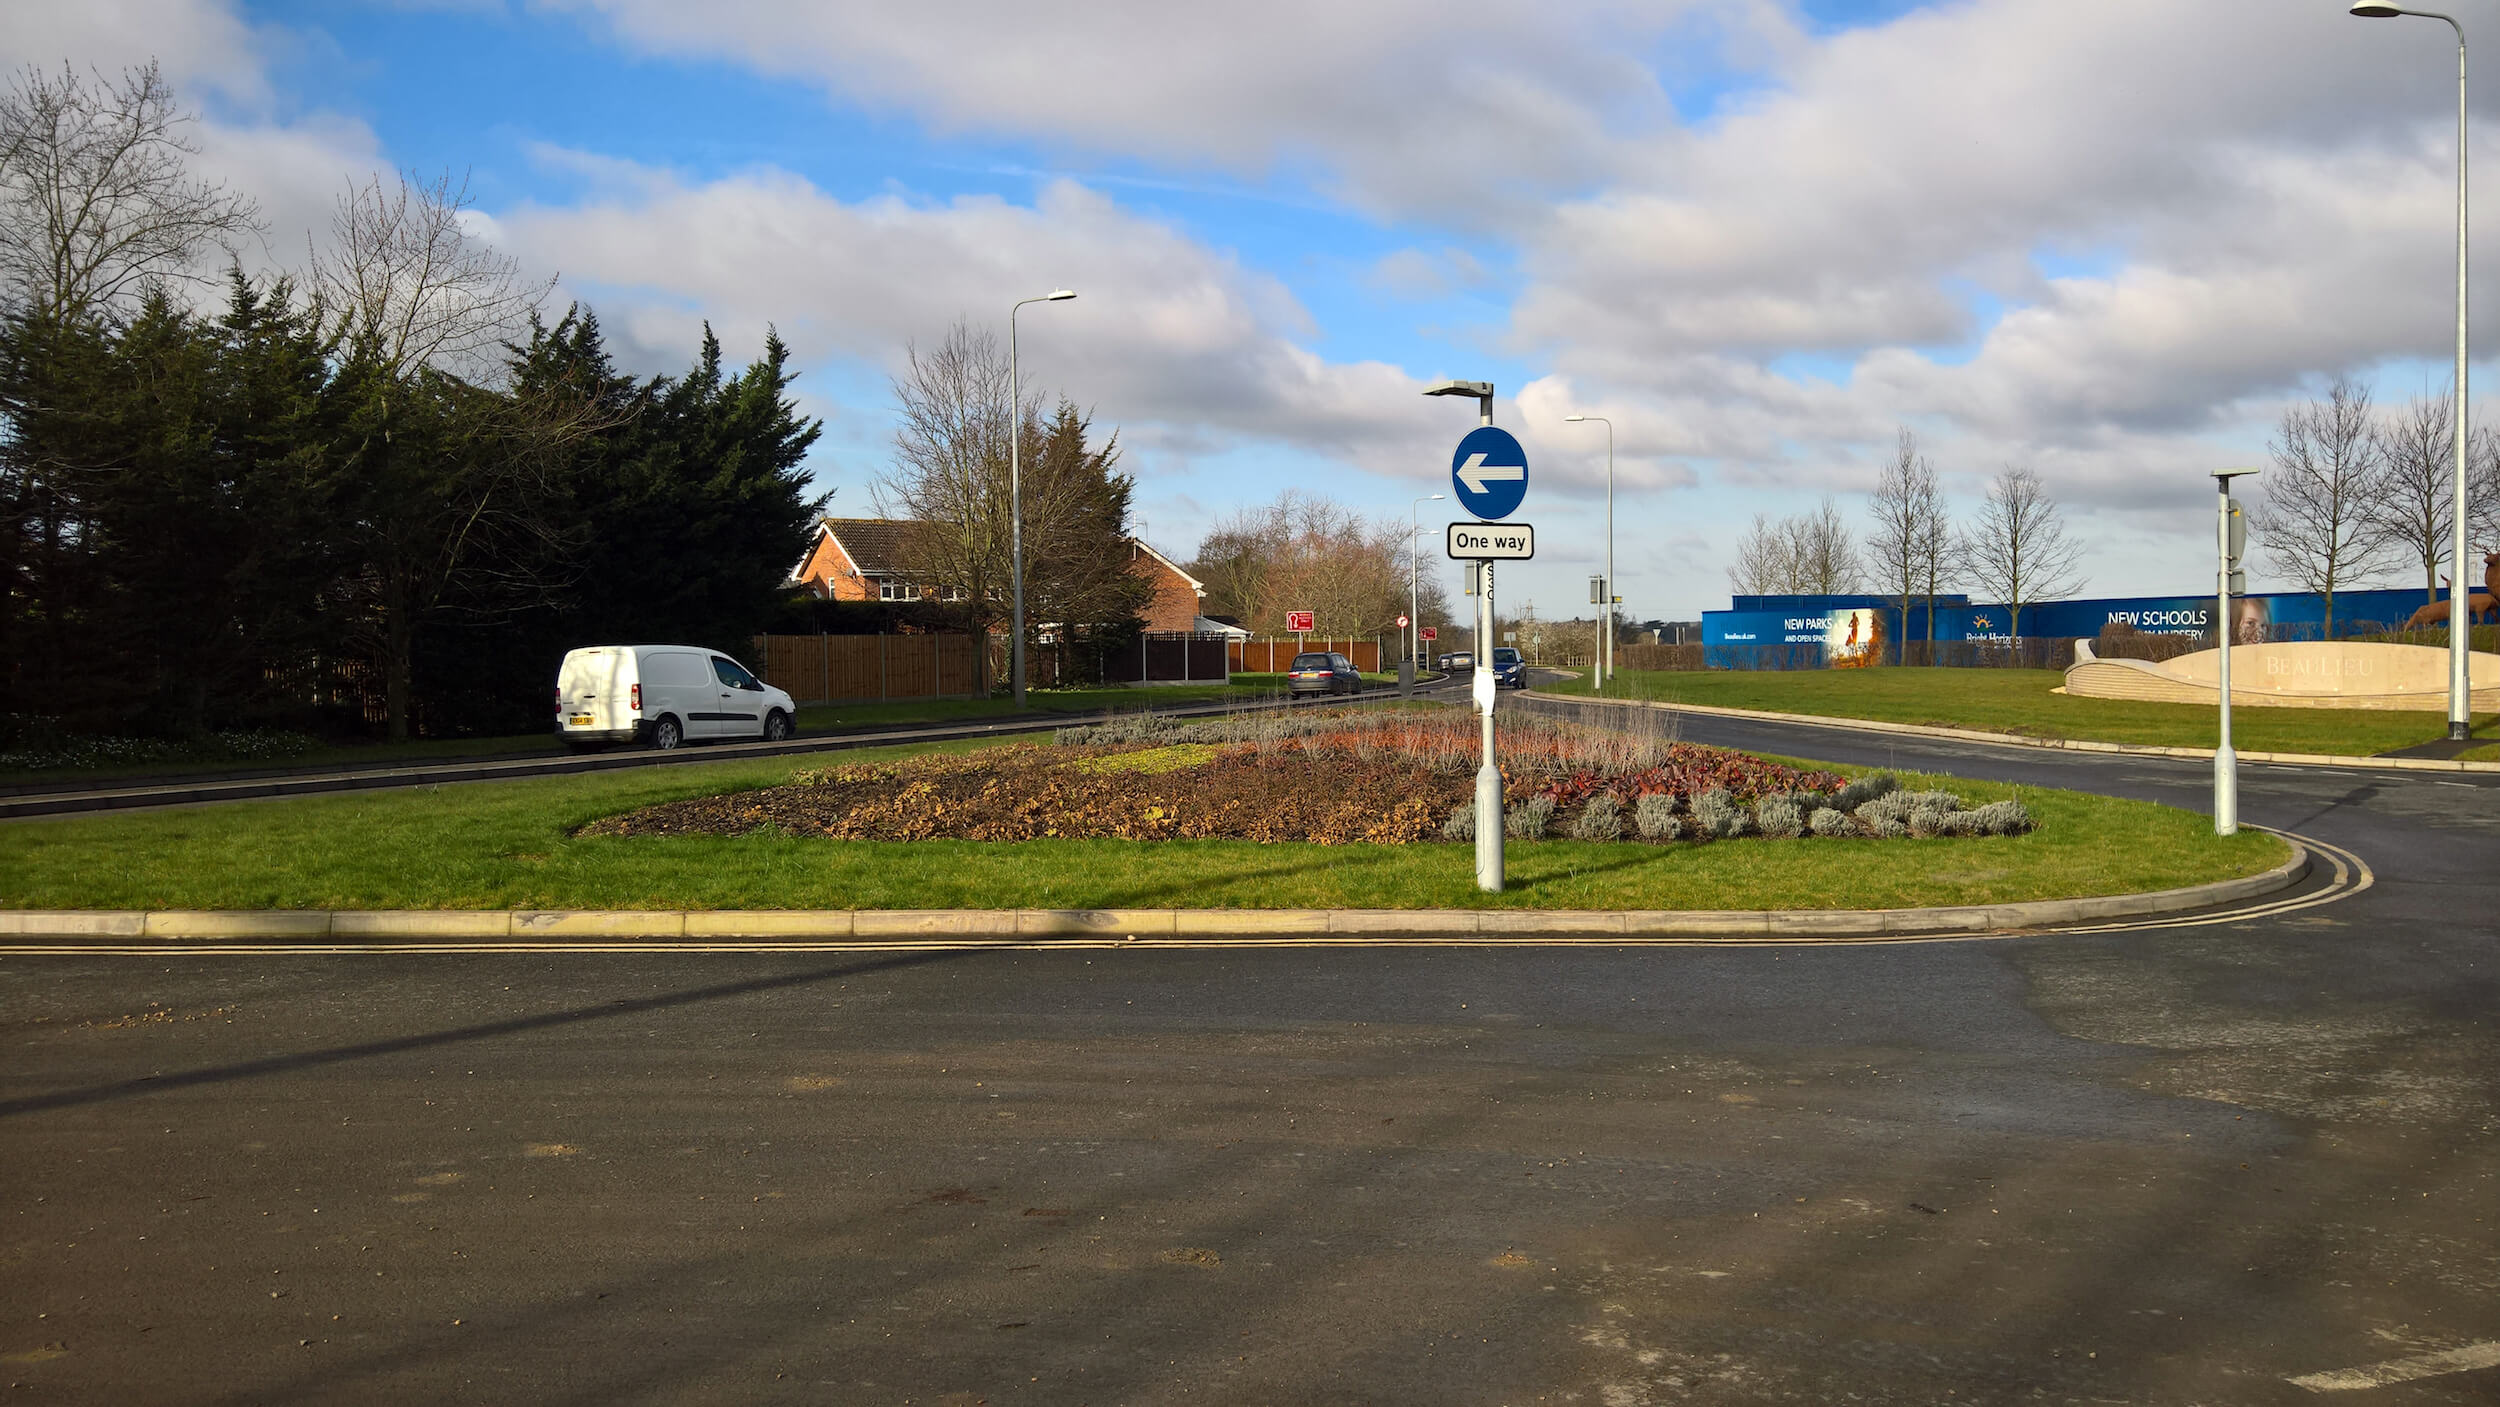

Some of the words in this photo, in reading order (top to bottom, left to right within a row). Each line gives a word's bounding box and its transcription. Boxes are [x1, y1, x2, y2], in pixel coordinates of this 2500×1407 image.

[1456, 532, 1489, 548] One
[1494, 537, 1526, 551] way
[1784, 618, 1805, 630] NEW
[1806, 618, 1832, 630] PARKS
[2108, 611, 2140, 625] NEW
[2142, 609, 2208, 626] SCHOOLS
[1784, 634, 1797, 643] AND
[1797, 634, 1812, 643] OPEN
[1812, 634, 1832, 642] SPACES
